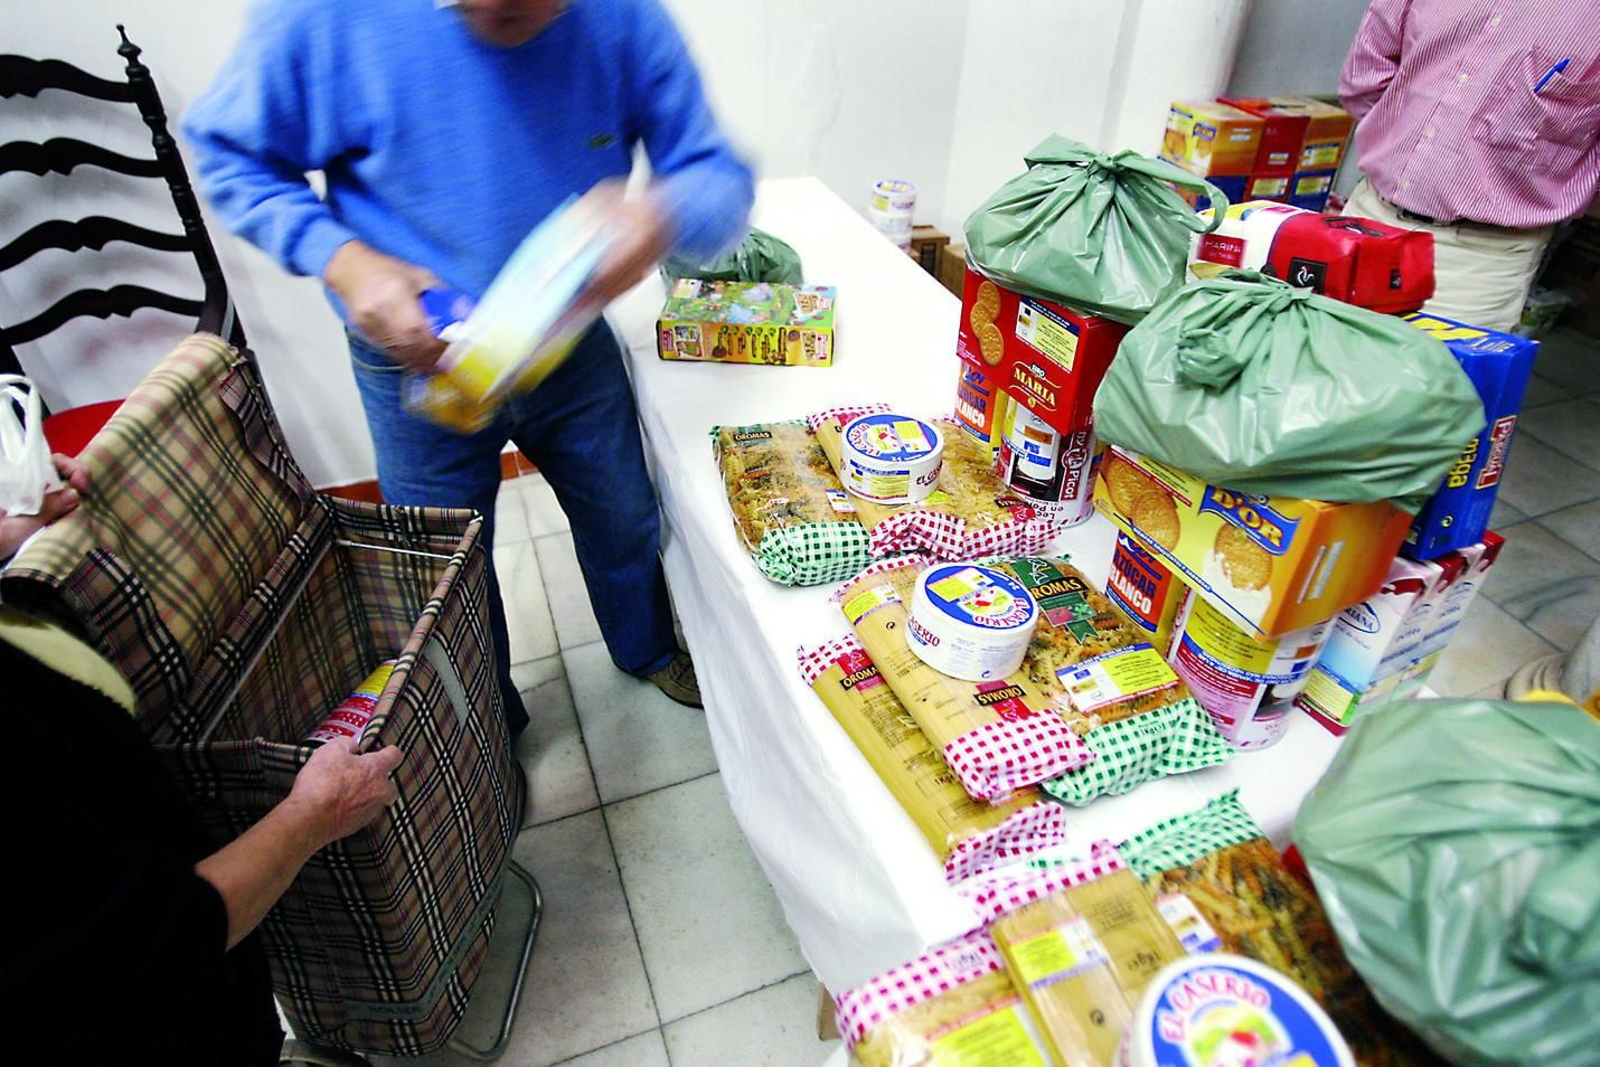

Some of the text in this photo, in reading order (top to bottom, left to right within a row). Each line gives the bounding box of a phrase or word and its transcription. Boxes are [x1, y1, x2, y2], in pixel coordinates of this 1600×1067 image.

[1013, 367, 1056, 406] MARIA
[735, 432, 770, 440] OROMAS
[1064, 469, 1081, 498] Picot
[1036, 510, 1055, 519] Lec
[1211, 486, 1282, 548] D'OR
[1113, 549, 1156, 599] AZUCAR
[1030, 579, 1082, 598] ROMAS
[974, 609, 1030, 627] CASERIO
[843, 668, 877, 687] OROMA
[978, 687, 1022, 704] OROMAS
[1164, 973, 1269, 1042] EL CASERIO
